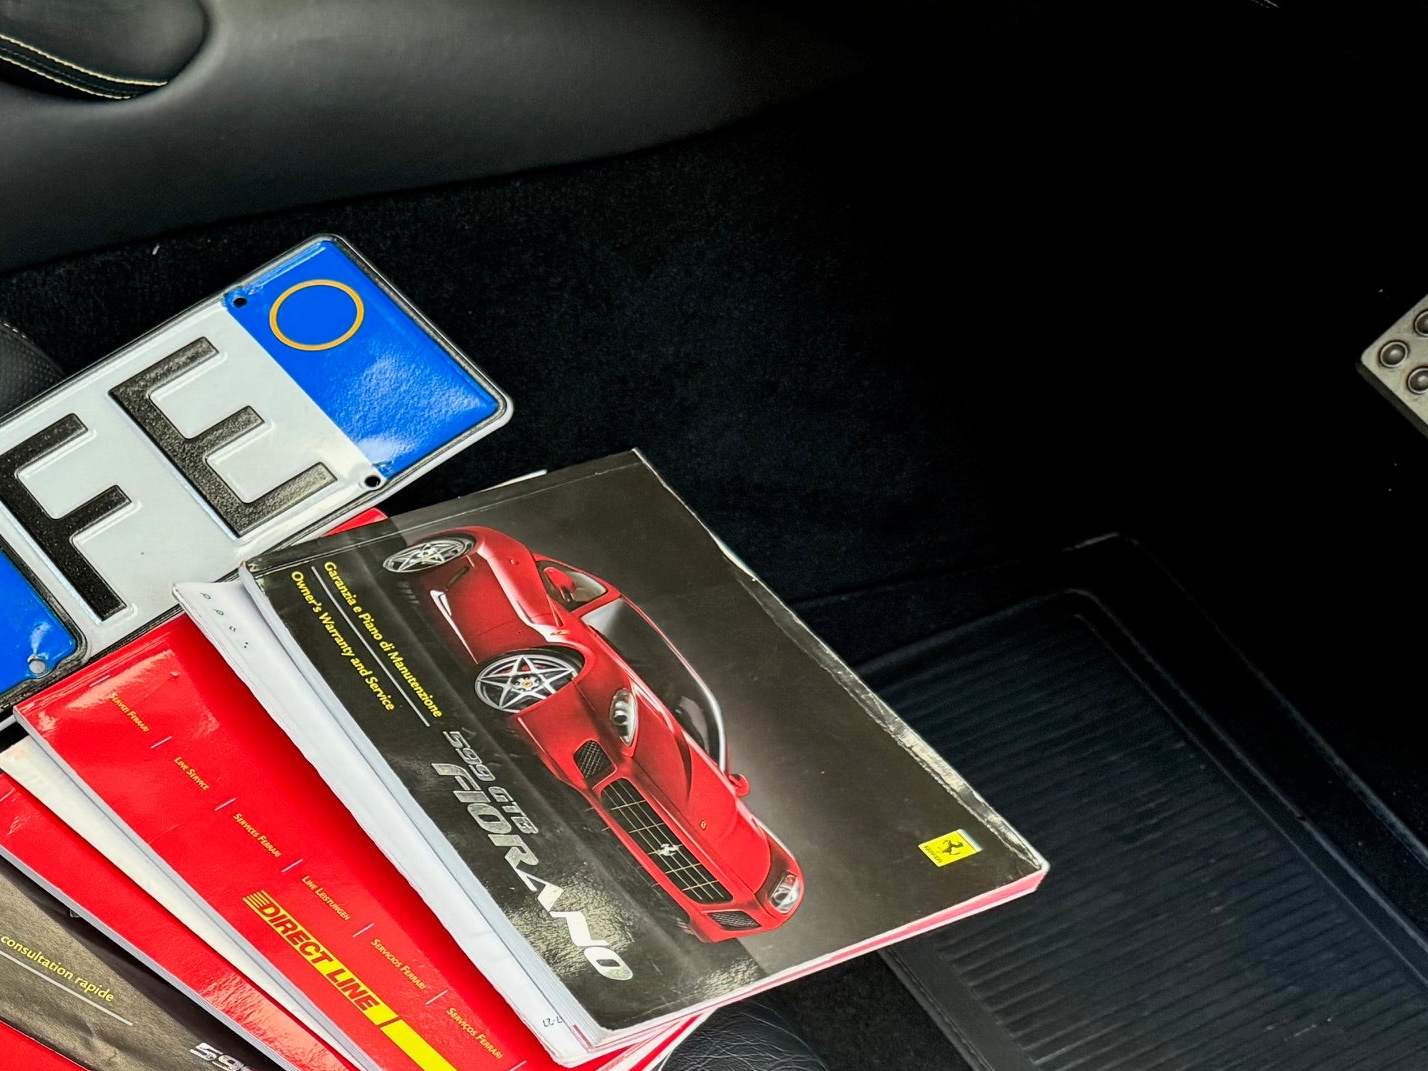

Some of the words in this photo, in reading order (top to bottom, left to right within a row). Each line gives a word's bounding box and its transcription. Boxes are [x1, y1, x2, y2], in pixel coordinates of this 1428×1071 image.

[291, 571, 322, 613] Owner's
[319, 612, 355, 658] Warranty
[350, 657, 373, 677] and
[365, 676, 395, 711] Service
[324, 561, 358, 606] Garanzia
[353, 606, 363, 614] e
[358, 613, 383, 642] Piano
[379, 640, 395, 652] di
[387, 646, 443, 718] Manutenzione
[443, 731, 496, 782] 599
[488, 786, 539, 834] GTB
[431, 762, 634, 981] FIORANO
[0, 933, 74, 981] consultation
[74, 976, 115, 1003] rapide
[258, 903, 335, 966] DIRECT
[326, 967, 381, 1012] LINE
